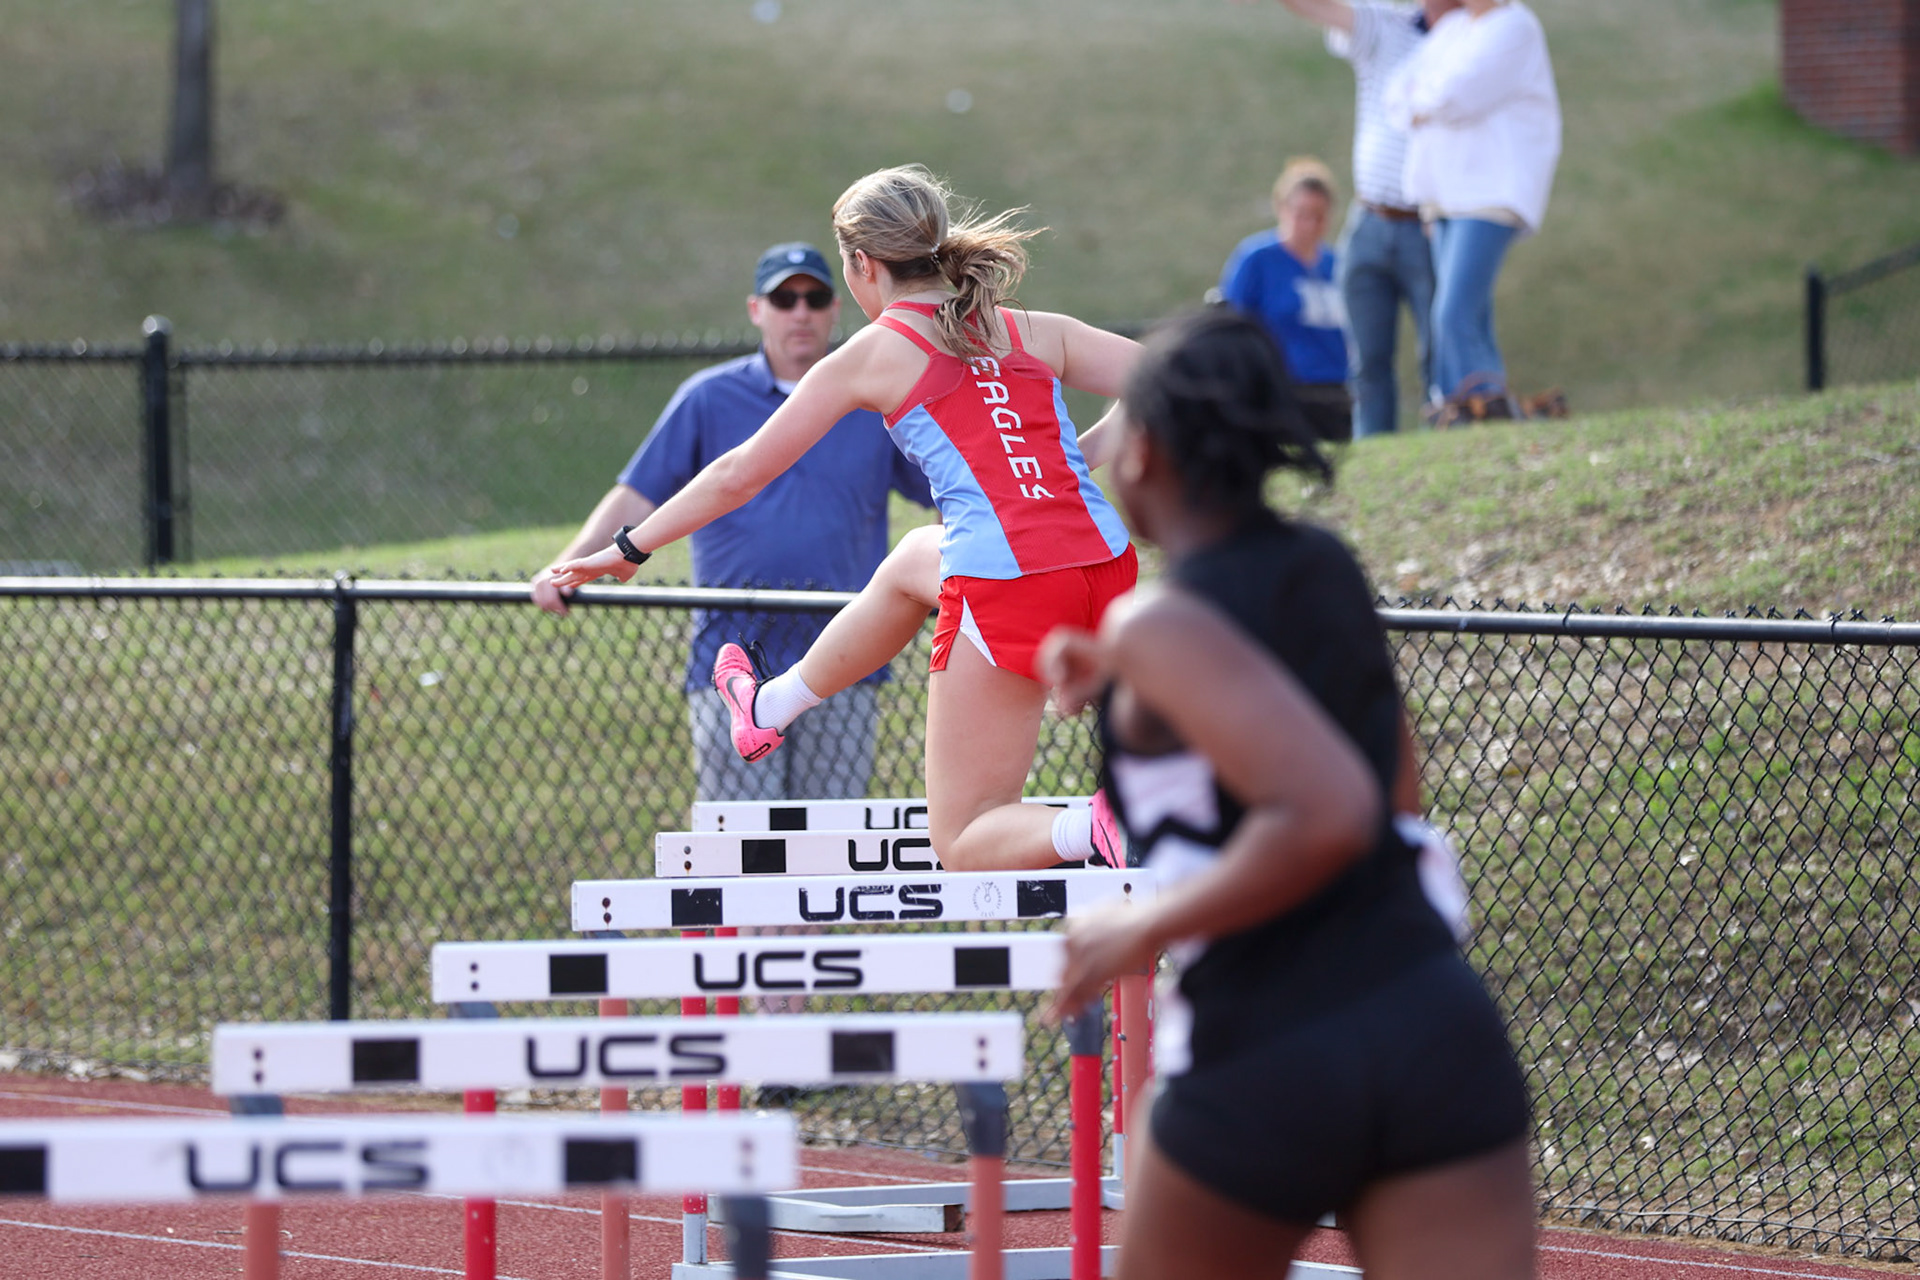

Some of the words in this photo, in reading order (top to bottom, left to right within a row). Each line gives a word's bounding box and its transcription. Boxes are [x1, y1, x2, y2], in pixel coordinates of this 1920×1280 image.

[865, 806, 928, 829] UC
[848, 838, 944, 871] UC
[799, 884, 943, 922] UCS
[694, 950, 863, 990] UCS
[526, 1033, 725, 1078] UCS
[185, 1140, 430, 1191] UCS
